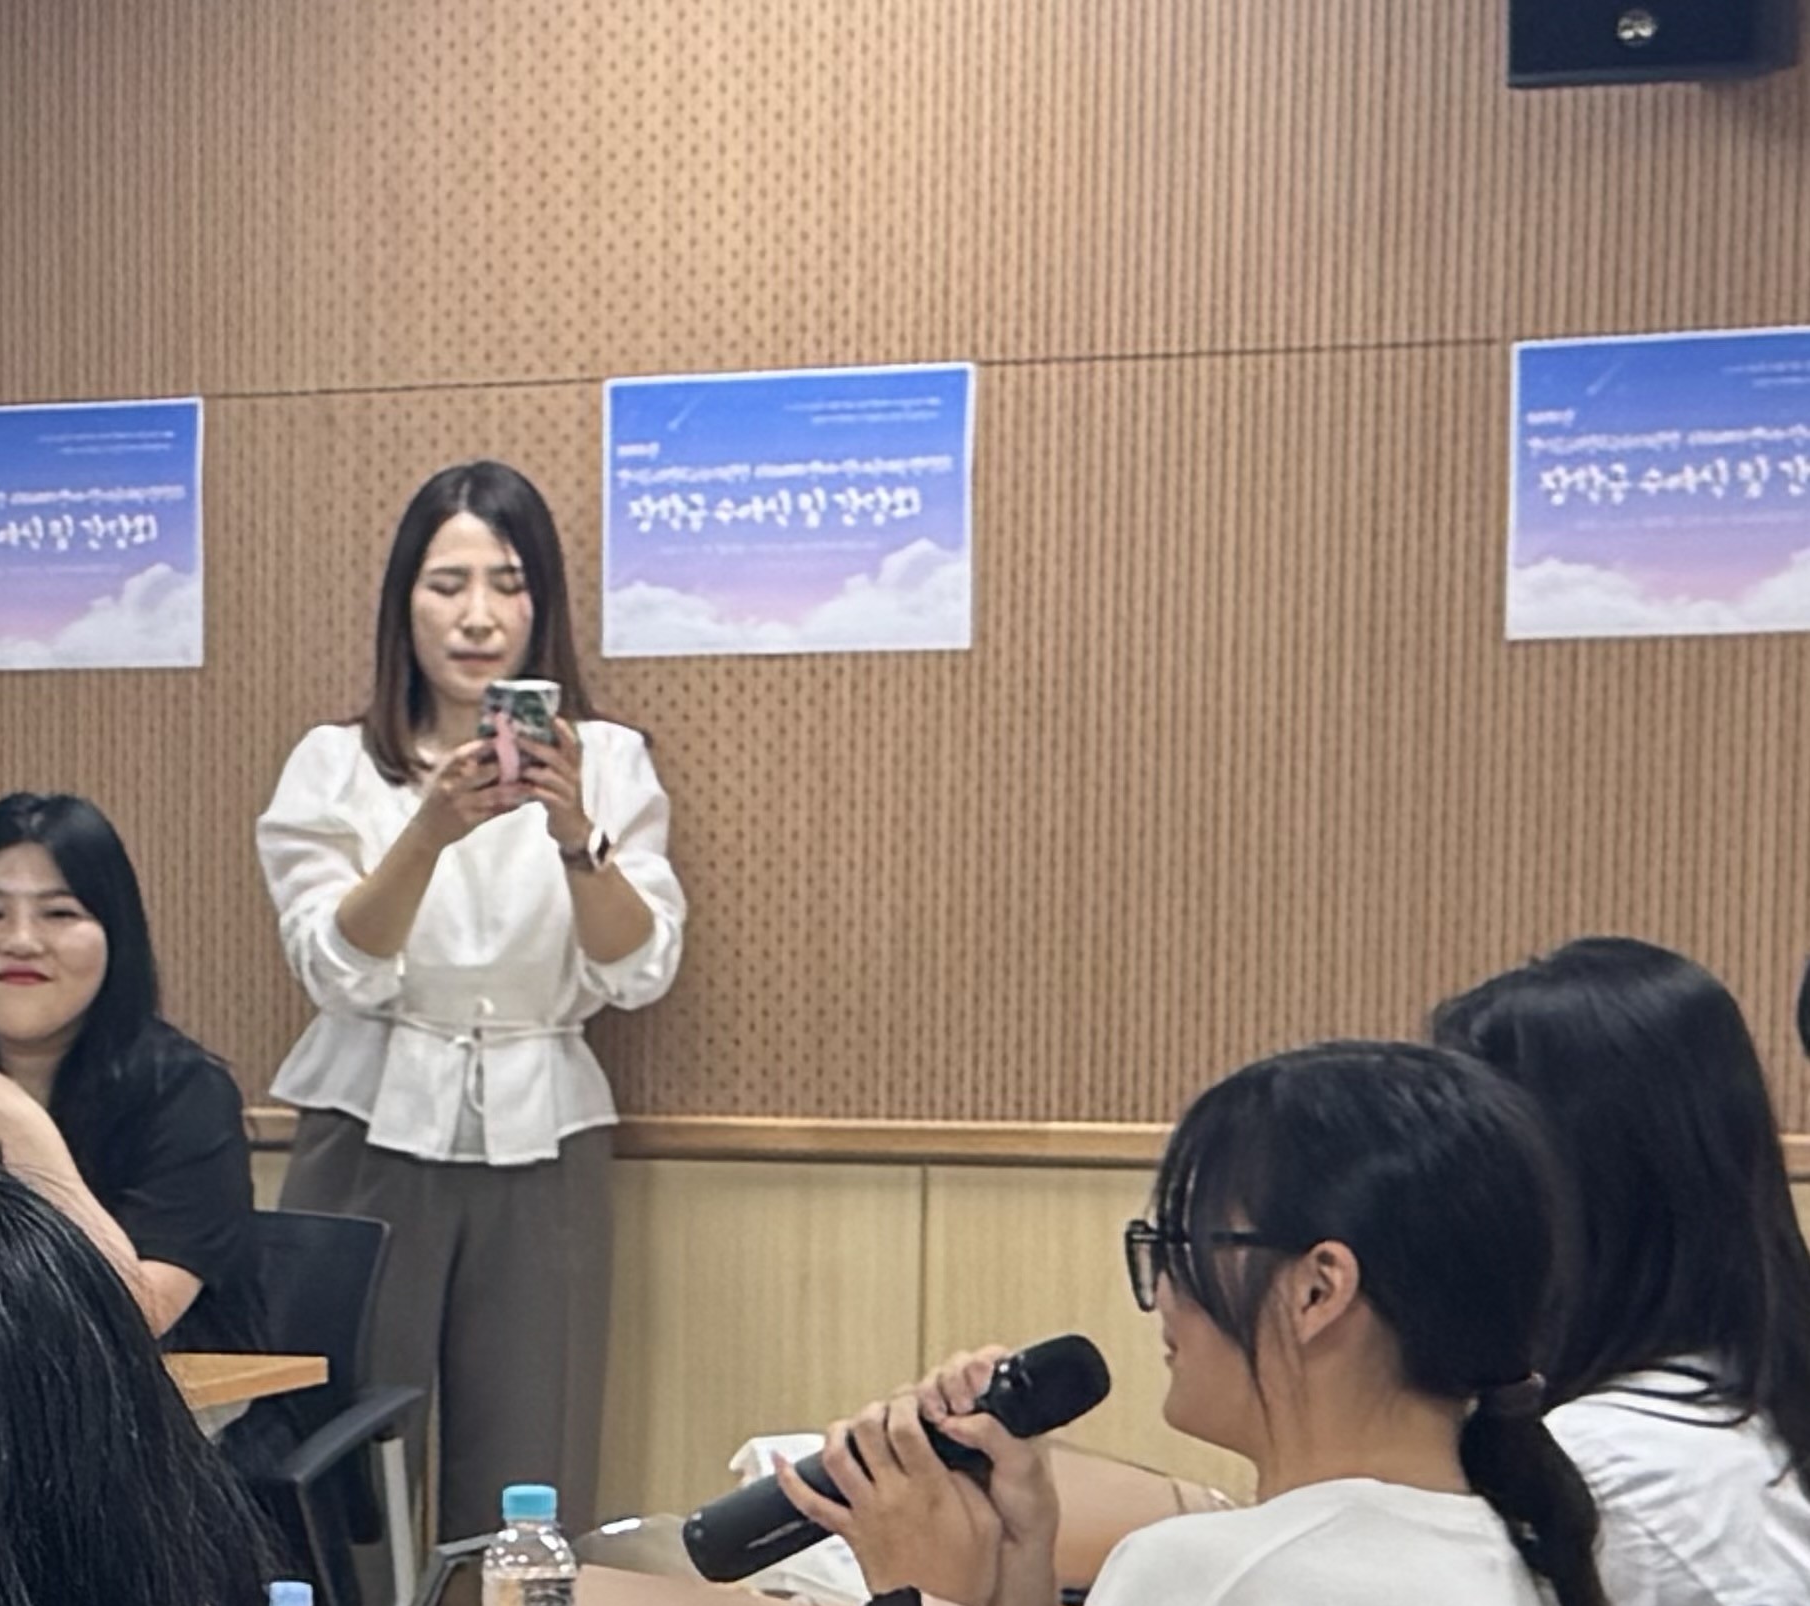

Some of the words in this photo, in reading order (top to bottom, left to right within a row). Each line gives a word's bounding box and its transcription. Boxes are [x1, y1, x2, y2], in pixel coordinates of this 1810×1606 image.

[1541, 462, 1631, 506] 장학금
[1638, 457, 1729, 499] 수여식
[629, 493, 708, 532] 장학금
[714, 488, 791, 528] 수여식
[833, 486, 921, 526] 간담회
